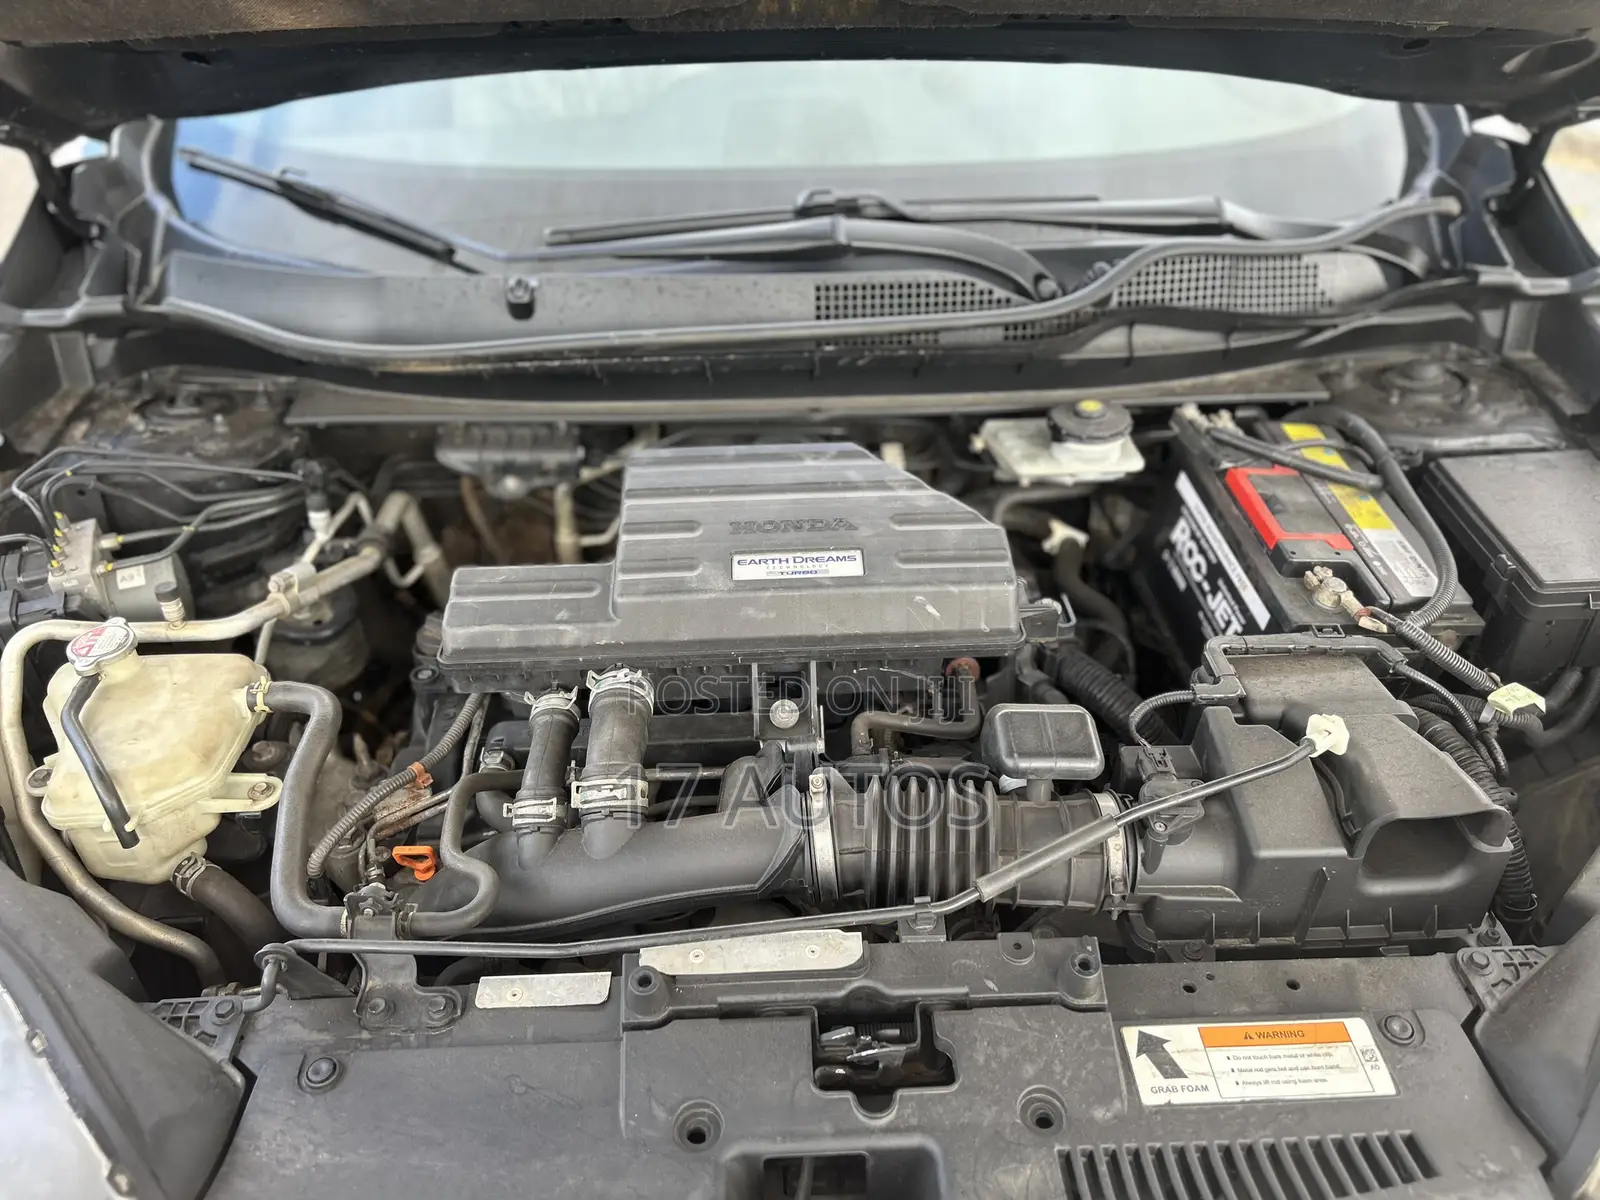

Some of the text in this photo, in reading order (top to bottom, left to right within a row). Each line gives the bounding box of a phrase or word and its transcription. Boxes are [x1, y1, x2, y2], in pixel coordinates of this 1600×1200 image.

[729, 517, 859, 535] HONDA
[737, 554, 858, 566] EARTH DREAMS
[1255, 1030, 1305, 1039] WARNING
[1150, 1084, 1209, 1094] GRAB FOAM
